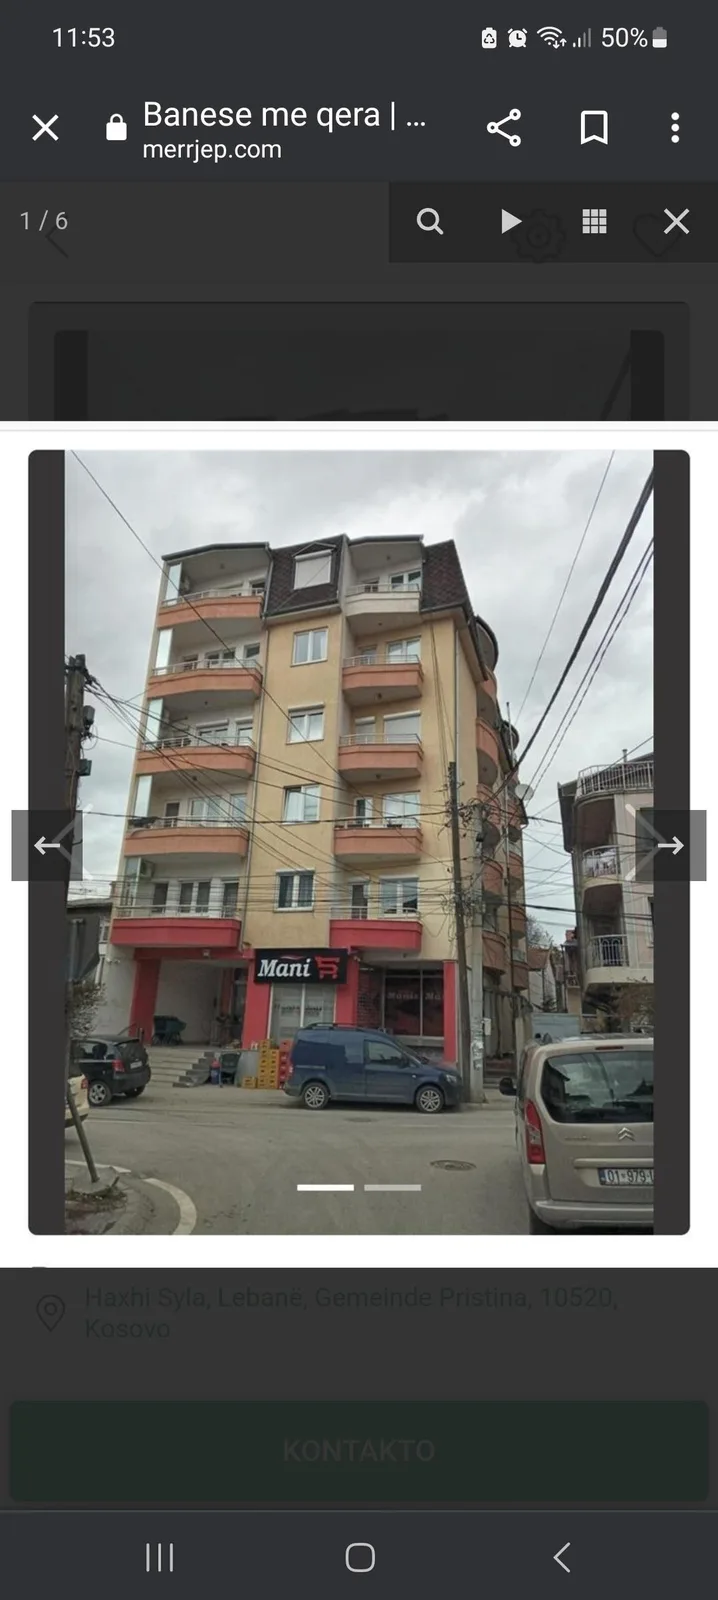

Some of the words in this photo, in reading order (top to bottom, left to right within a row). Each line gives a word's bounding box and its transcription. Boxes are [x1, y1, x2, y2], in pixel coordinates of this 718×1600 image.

[52, 27, 115, 47] 11:53
[601, 27, 648, 47] 50%
[144, 102, 252, 126] Banese
[262, 107, 307, 126] me
[316, 107, 379, 133] qera
[143, 139, 282, 163] merrjep.com
[21, 211, 28, 230] 1
[56, 211, 68, 230] 6
[257, 958, 311, 977] Mani
[85, 1287, 149, 1307] Haxhi
[158, 1287, 210, 1313] Syla,
[218, 1287, 307, 1311] Lebanë,
[315, 1287, 431, 1308] Gemeinde
[440, 1287, 532, 1311] Pristina,
[542, 1287, 618, 1311] 10520,
[85, 1318, 170, 1338] Kosovo
[283, 1440, 436, 1461] KONTAKTO
